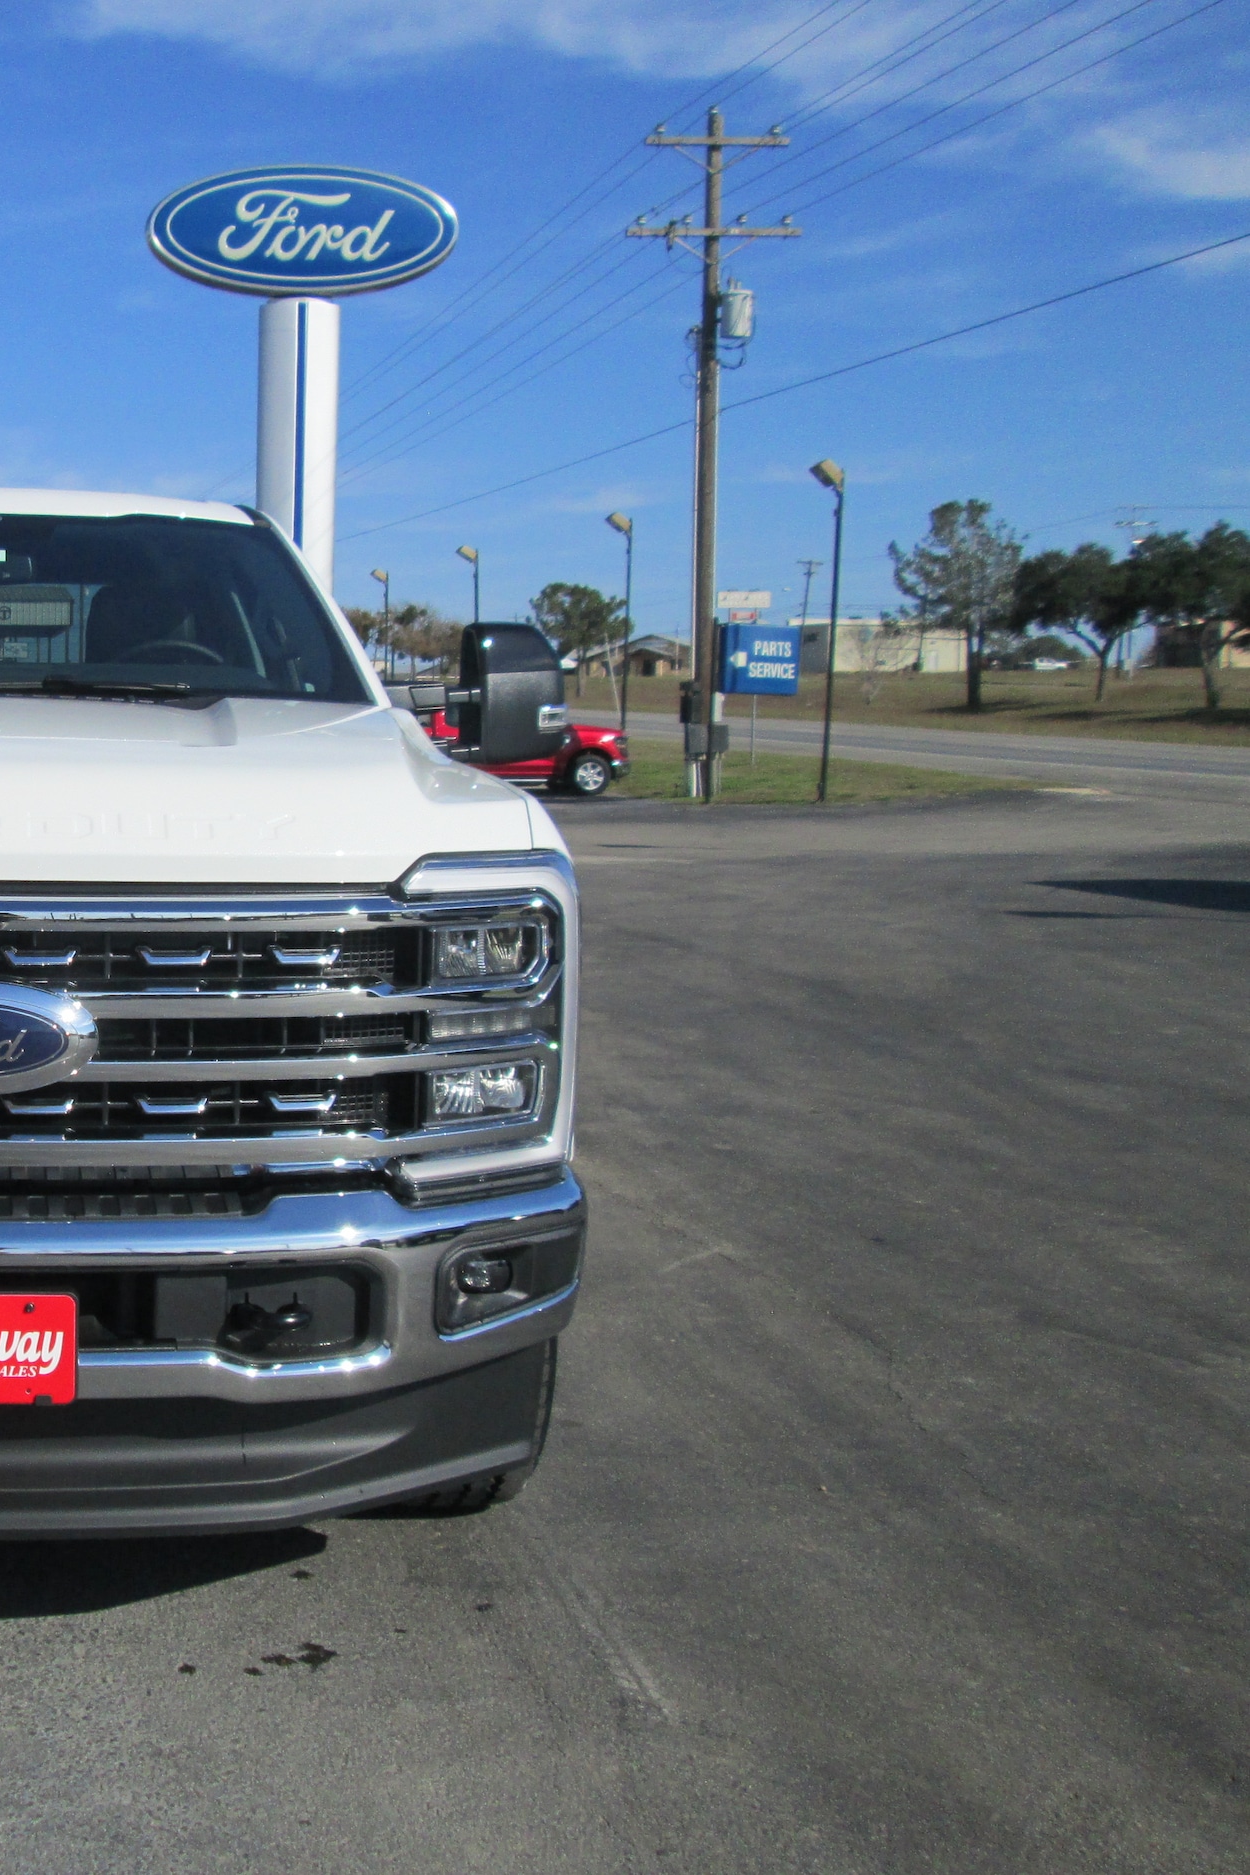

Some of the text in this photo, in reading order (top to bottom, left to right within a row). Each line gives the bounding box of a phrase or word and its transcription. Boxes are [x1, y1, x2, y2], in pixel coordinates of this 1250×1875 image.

[217, 189, 395, 262] Ford
[754, 641, 792, 657] PARTS
[748, 662, 796, 679] SERVICE
[26, 810, 296, 841] DUTY
